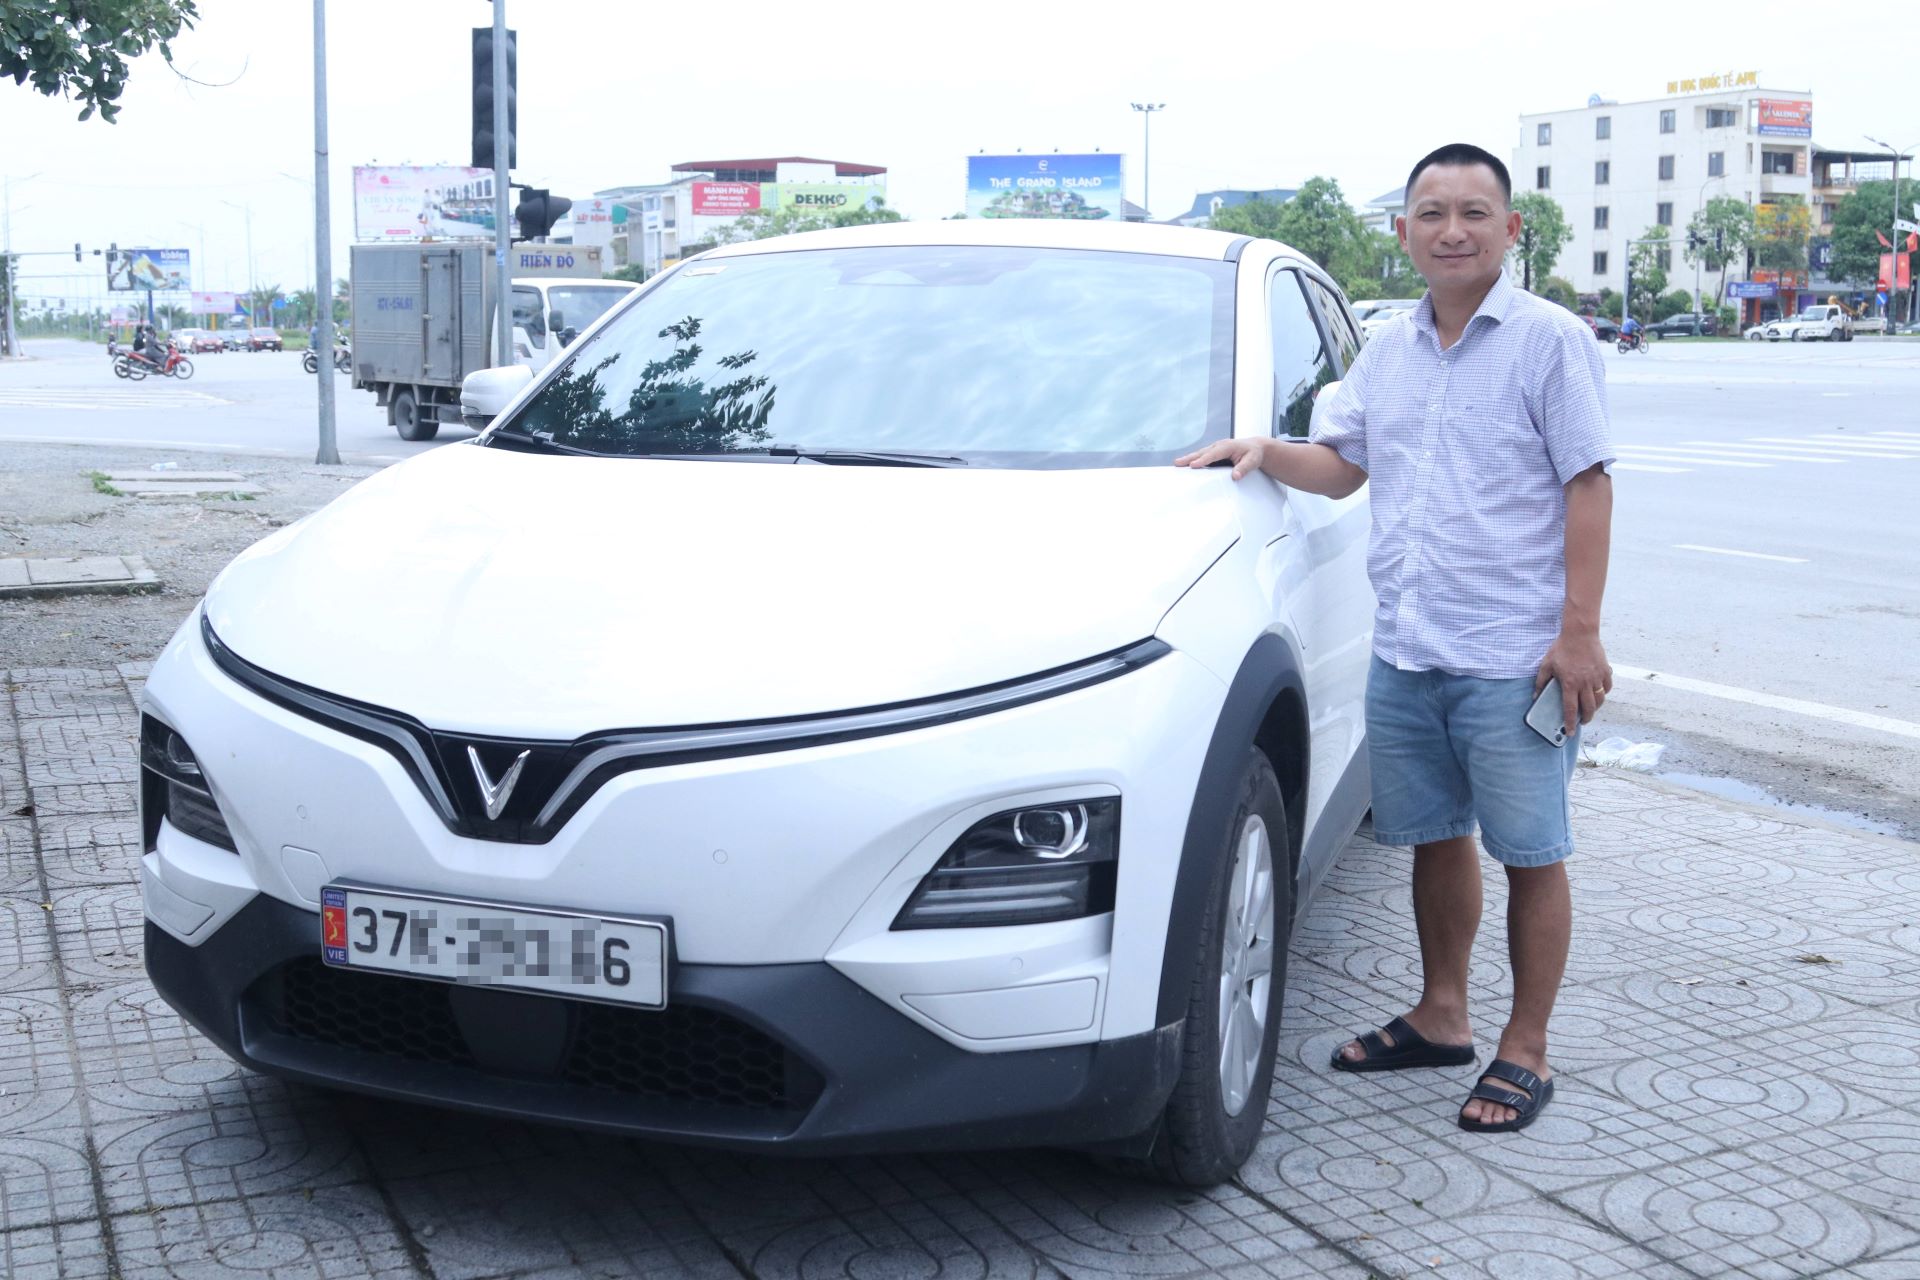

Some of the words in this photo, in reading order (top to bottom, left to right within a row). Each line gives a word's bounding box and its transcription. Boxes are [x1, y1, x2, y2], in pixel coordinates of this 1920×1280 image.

[989, 177, 1012, 188] THE
[1016, 177, 1056, 188] GRAND
[1062, 177, 1102, 188] ISLAND
[795, 193, 847, 206] DEKKO
[328, 949, 345, 960] VIE
